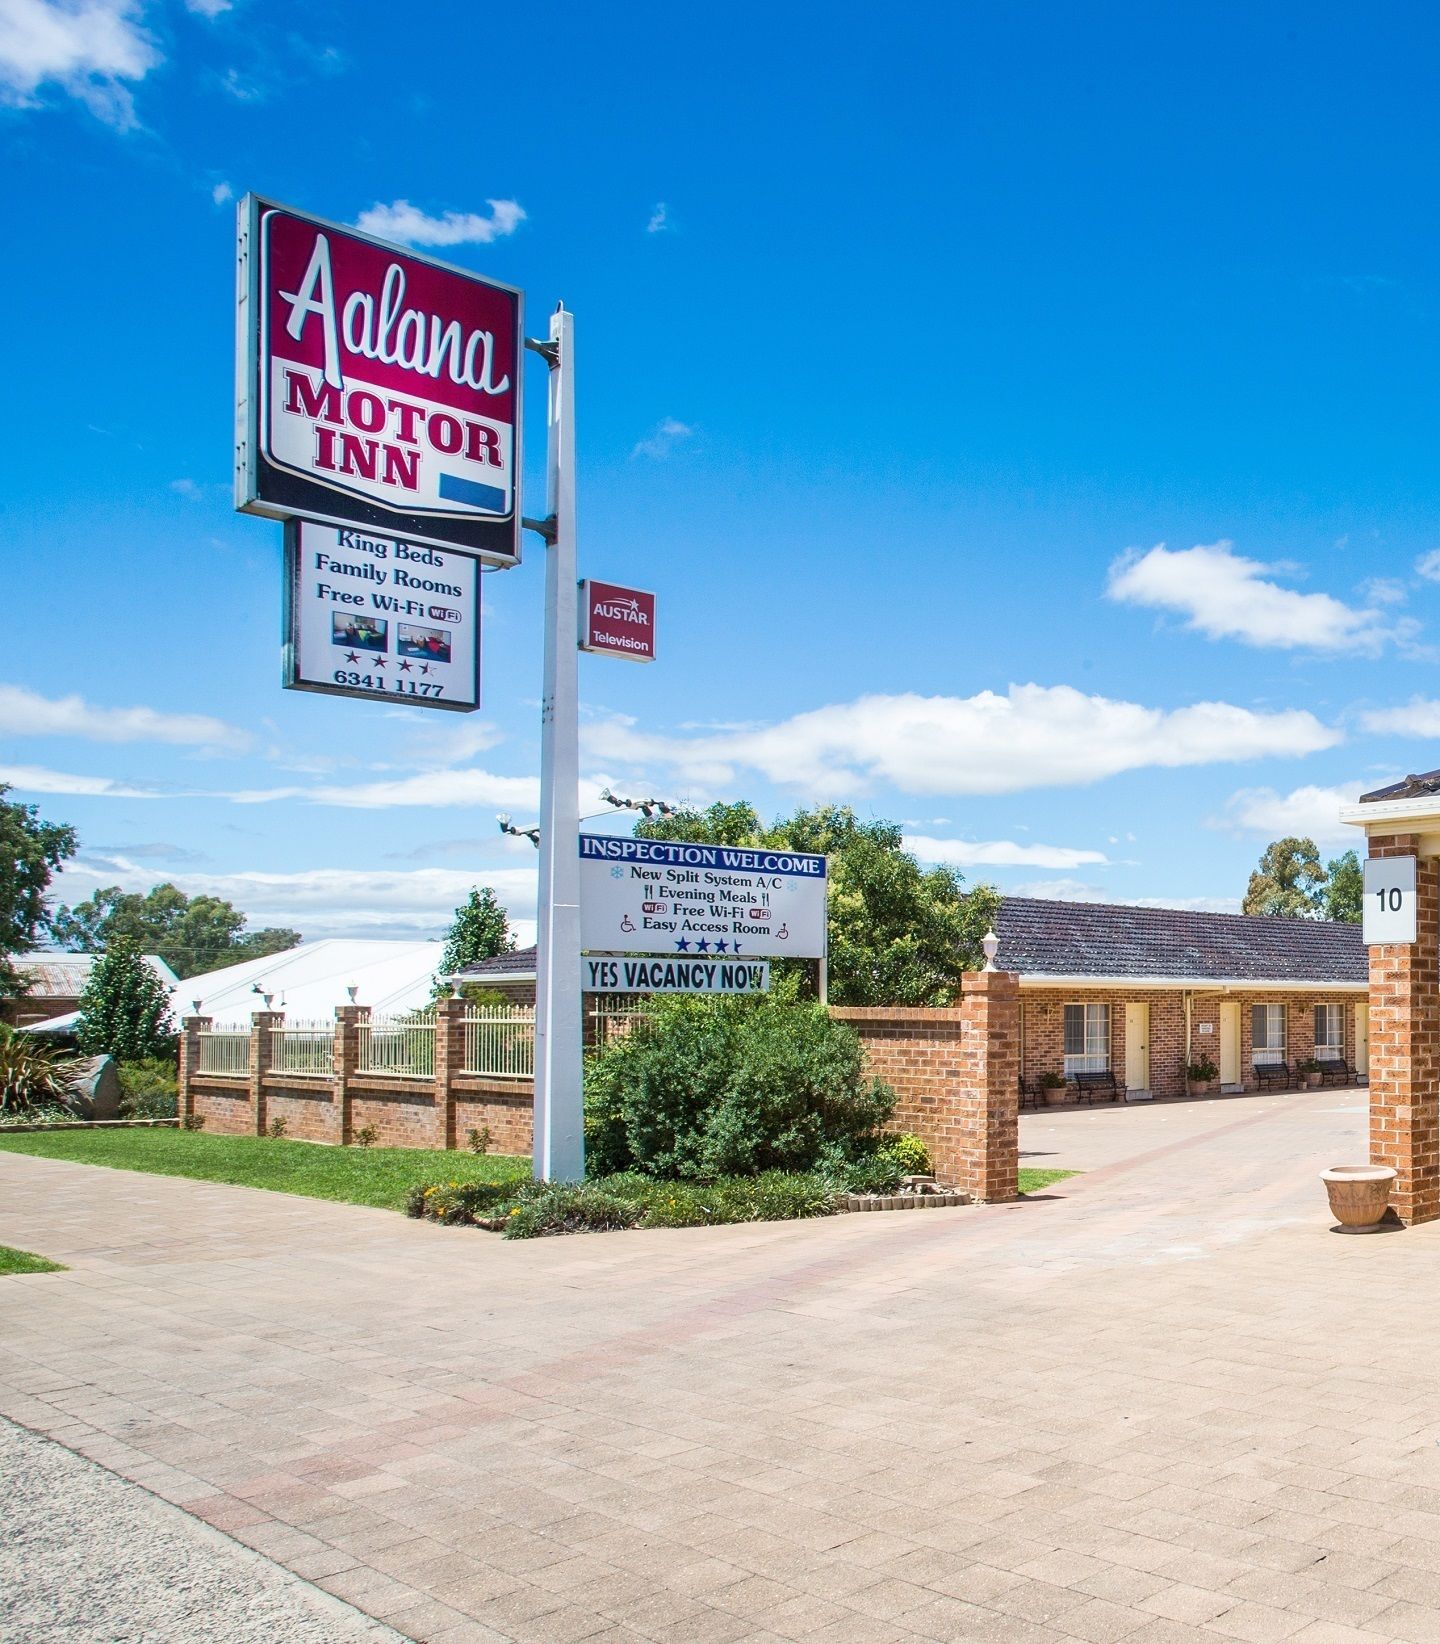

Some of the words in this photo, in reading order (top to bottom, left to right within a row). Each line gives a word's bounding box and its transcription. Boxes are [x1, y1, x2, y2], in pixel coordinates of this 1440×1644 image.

[278, 233, 509, 394] Aalana
[283, 368, 504, 469] MOTOR
[312, 425, 421, 492] INN
[337, 529, 388, 558] King
[394, 541, 444, 567] Beds
[315, 553, 388, 585] Family
[394, 569, 462, 597] Rooms
[317, 583, 364, 606] Free
[371, 594, 424, 617] Wi-Fi
[593, 603, 649, 625] AUSTAR
[593, 630, 648, 651] Television
[334, 670, 386, 690] 6341
[396, 679, 444, 697] 1177
[583, 838, 716, 865] INSPECTION
[723, 851, 820, 874] WELCOME
[630, 866, 662, 881] New
[666, 867, 700, 885] Split
[704, 873, 752, 888] System
[756, 877, 782, 890] A/C
[659, 886, 715, 902] Evening
[719, 890, 757, 904] Meals
[1376, 887, 1402, 912] 10
[673, 903, 705, 917] Free
[710, 905, 744, 919] Wi-Fi
[643, 917, 677, 932] Easy
[681, 919, 729, 933] Access
[732, 922, 770, 935] Room
[589, 961, 618, 987] YES
[624, 962, 716, 988] VACANCY
[721, 964, 764, 989] NOW
